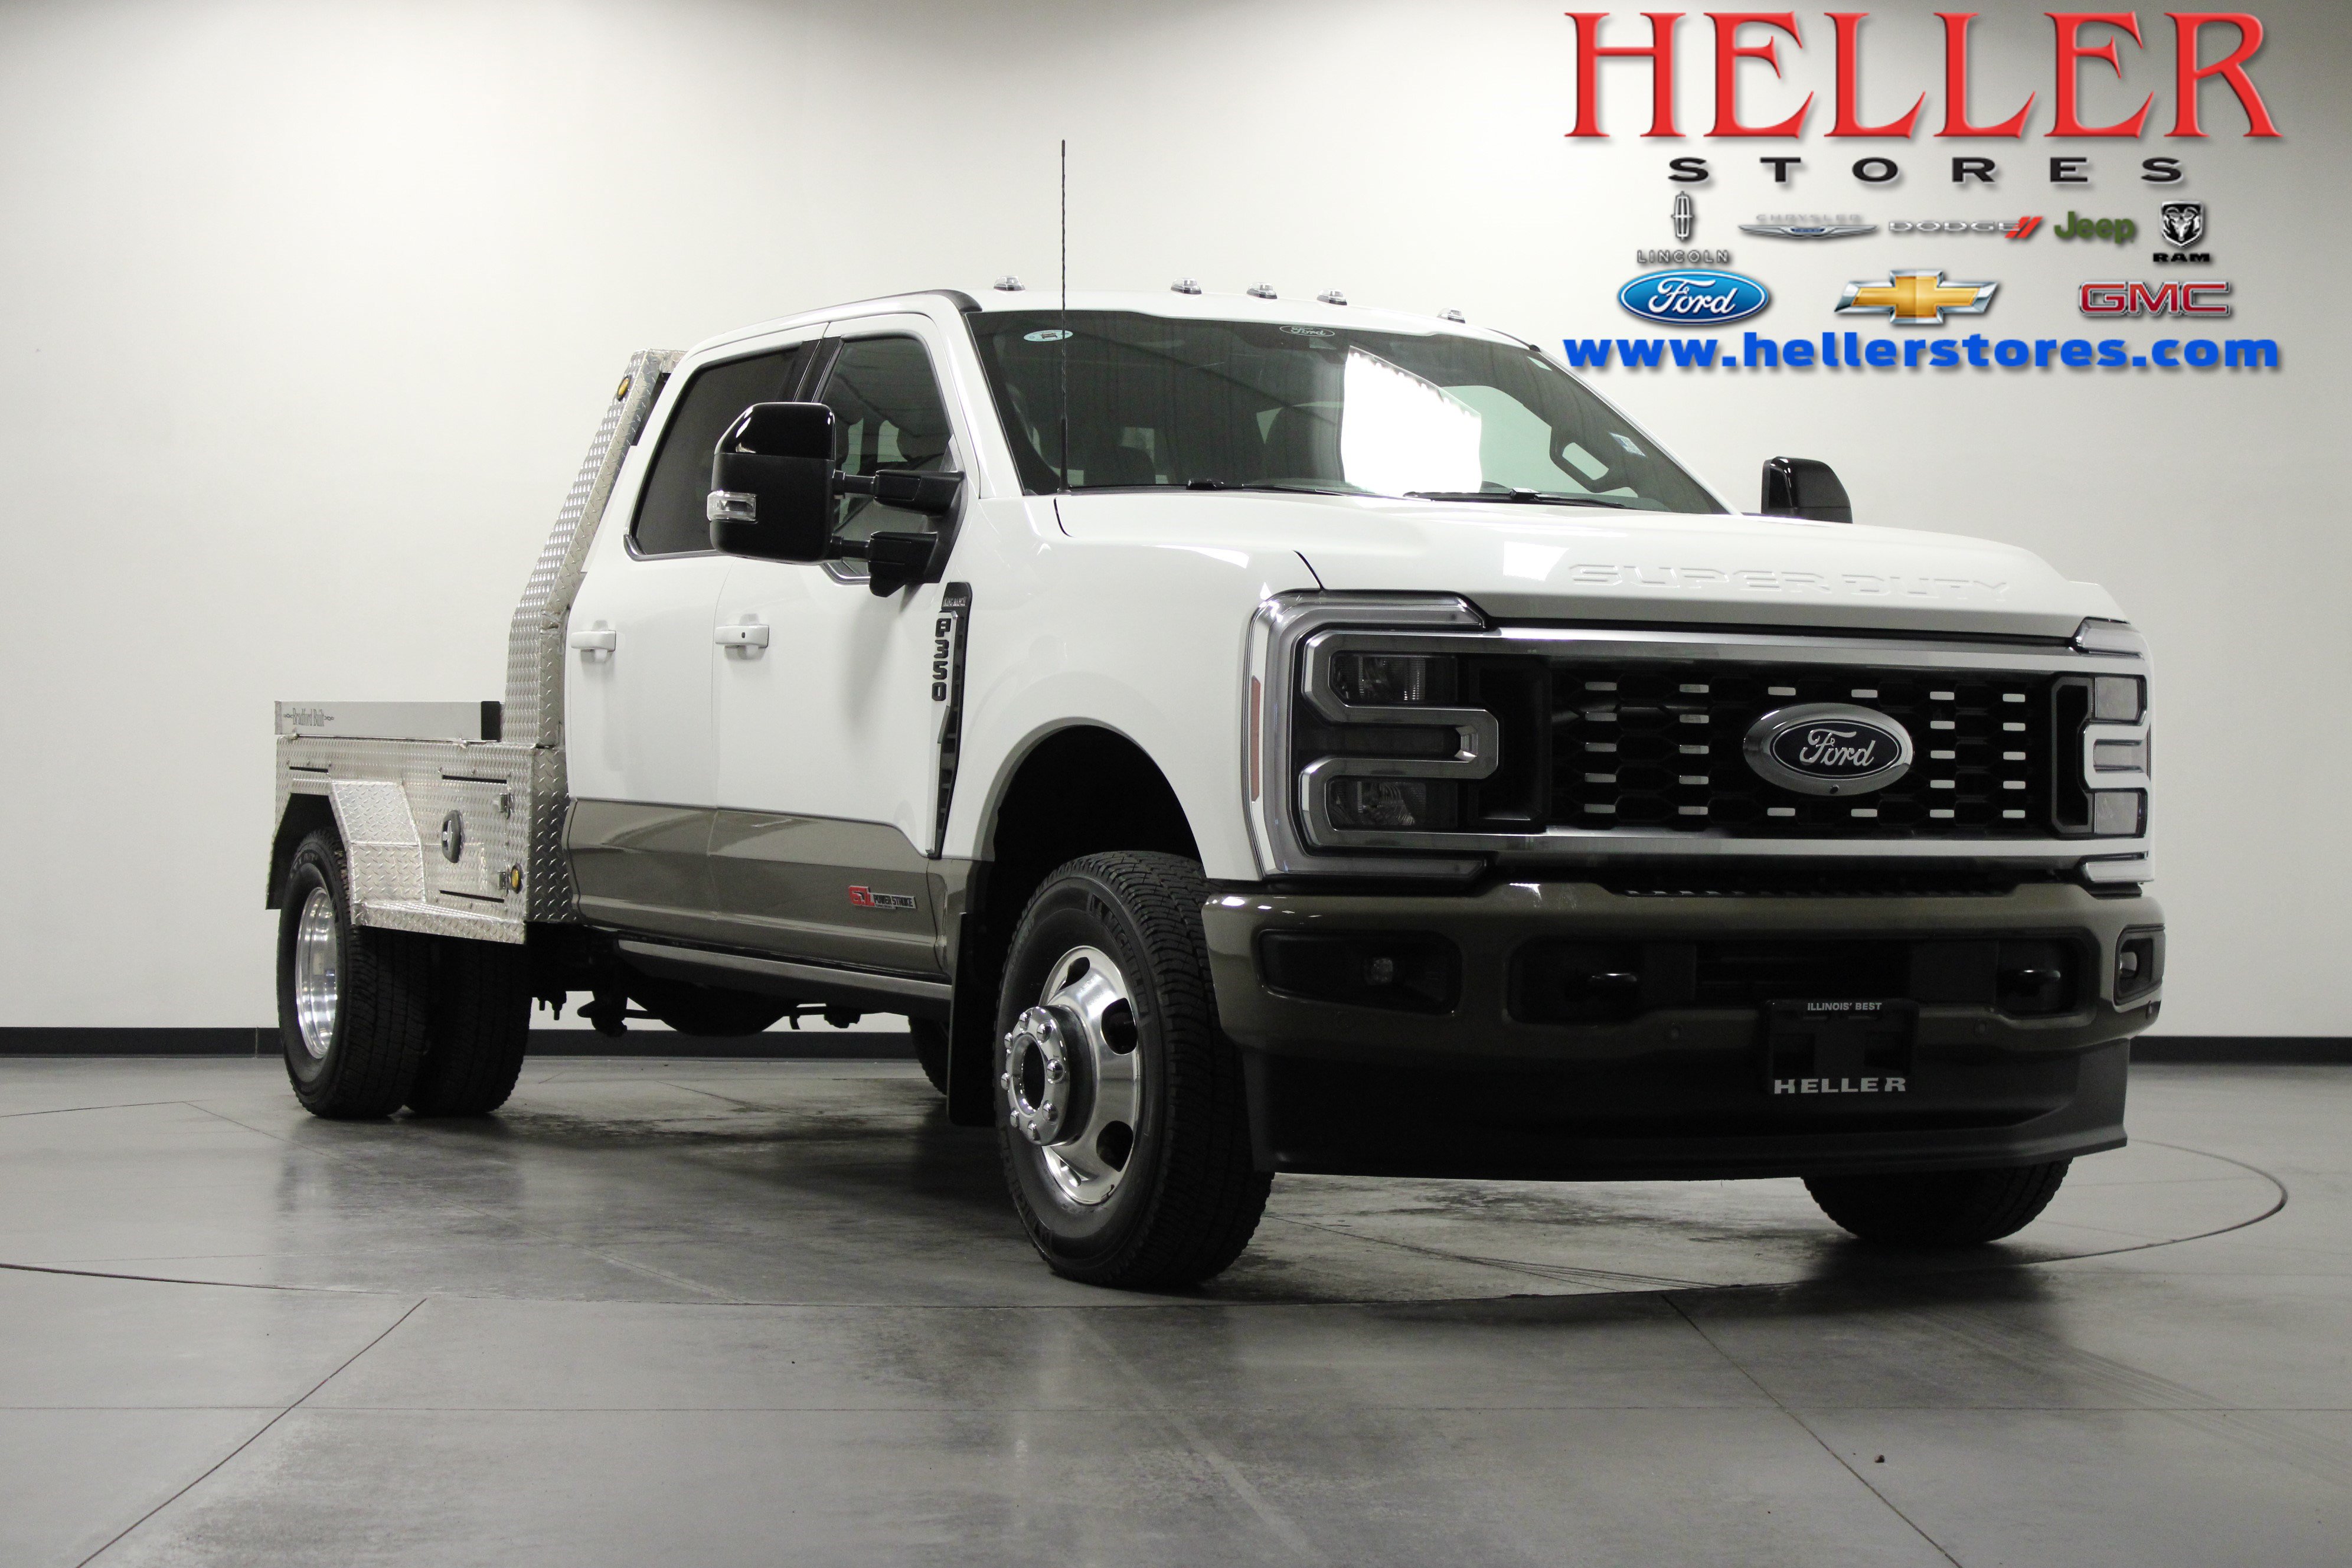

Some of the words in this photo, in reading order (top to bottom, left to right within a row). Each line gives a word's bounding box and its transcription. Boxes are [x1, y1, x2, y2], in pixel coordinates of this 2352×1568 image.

[1290, 326, 1326, 335] Ford
[1569, 564, 1832, 593] SUPER
[1841, 574, 2010, 601] DUTY
[293, 708, 313, 726] Bradford
[313, 709, 324, 727] Built
[1799, 728, 1875, 767] Ford
[873, 894, 892, 905] POWER
[891, 896, 914, 907] STROKE
[1807, 1002, 1853, 1011] ILLINOIS'
[1774, 1077, 1906, 1094] HELLER
